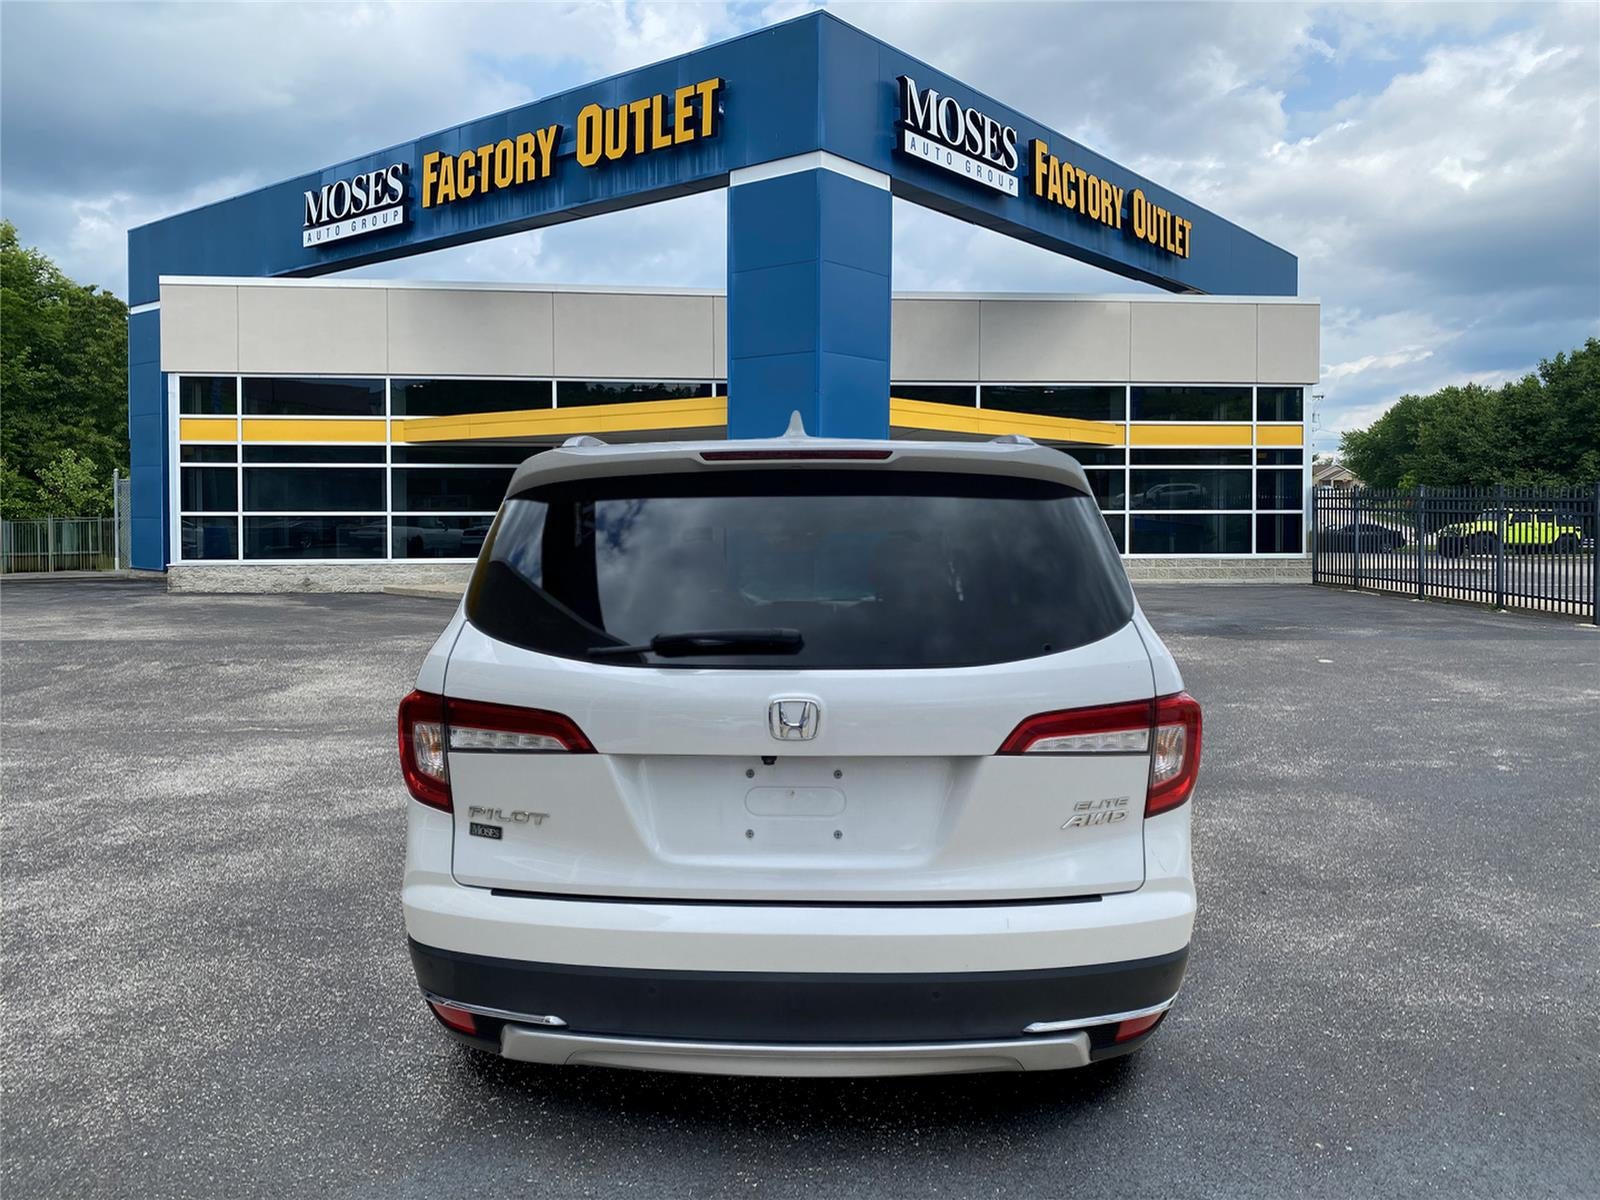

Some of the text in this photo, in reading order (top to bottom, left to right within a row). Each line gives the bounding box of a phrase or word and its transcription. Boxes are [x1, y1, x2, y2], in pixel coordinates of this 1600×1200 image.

[422, 77, 720, 208] FACTORY OUTLET
[904, 75, 1018, 171] MOSES
[910, 136, 1015, 191] AUTO GROUP
[303, 163, 405, 226] MOSES
[1034, 138, 1192, 259] FACTORY OUTLET
[307, 210, 400, 243] AUTO GROUP
[468, 806, 550, 825] PILOT
[1061, 809, 1128, 829] AWD
[1073, 796, 1129, 811] ELITE
[471, 824, 501, 839] MOSES
